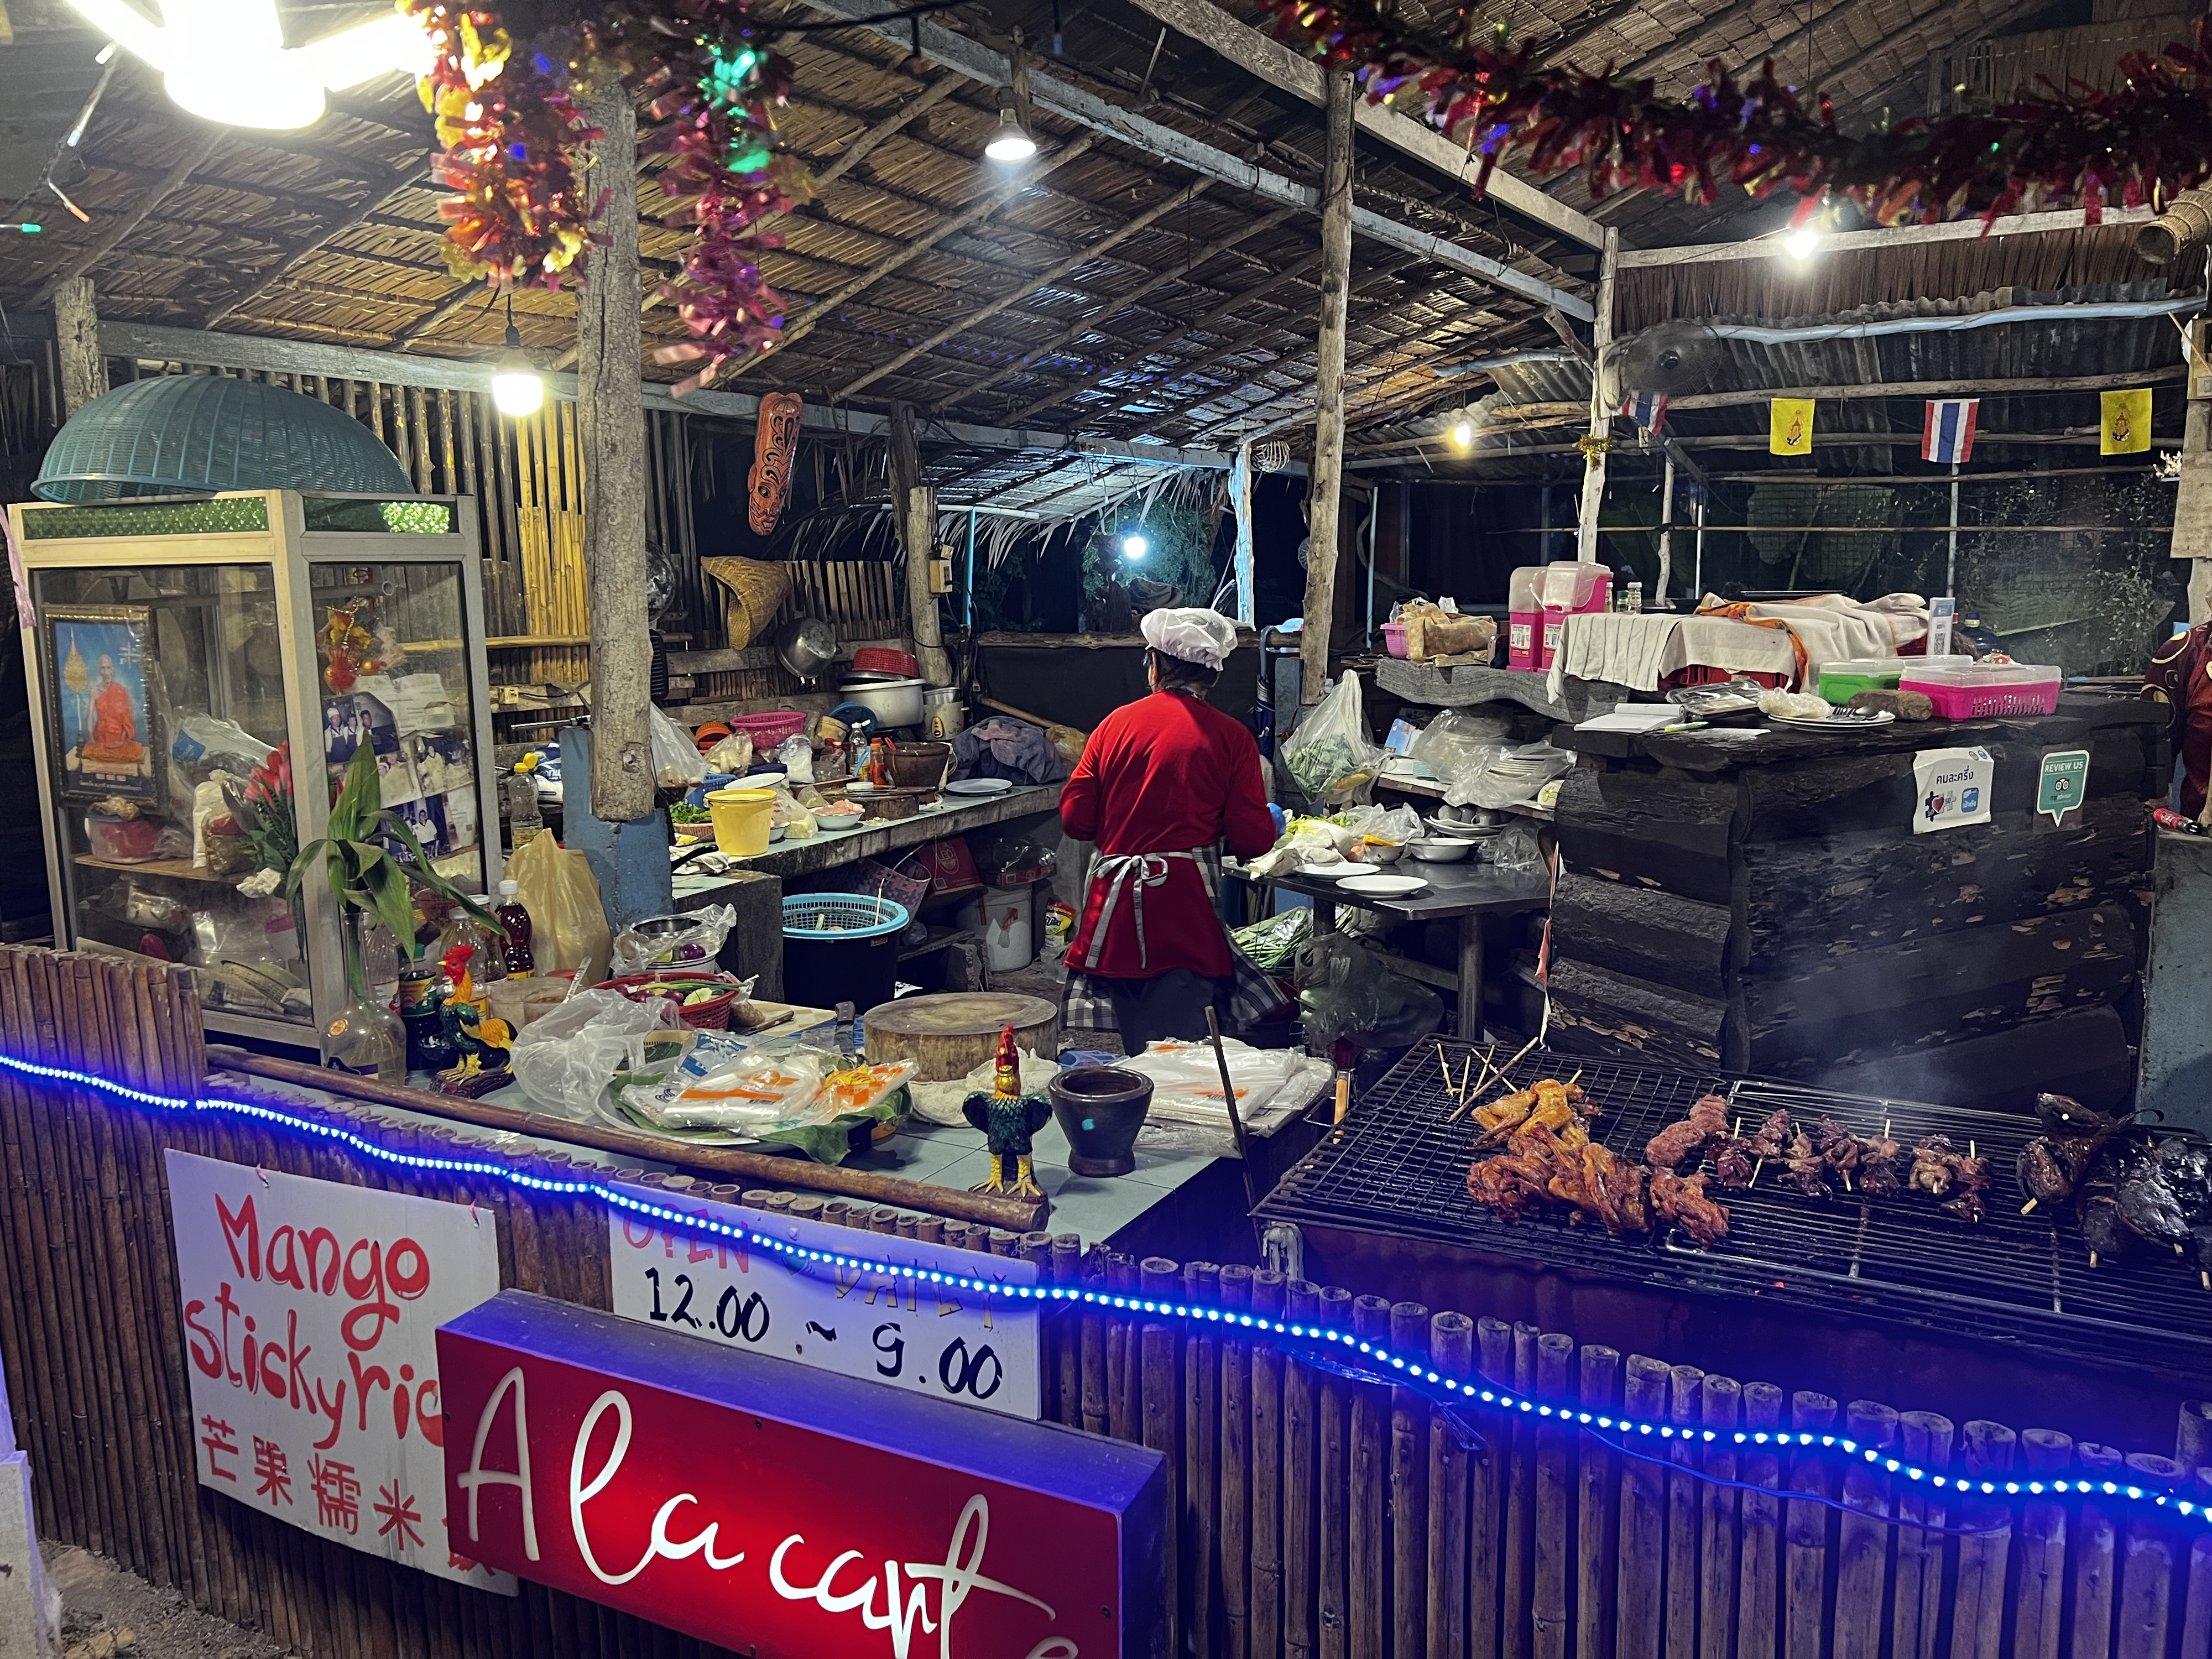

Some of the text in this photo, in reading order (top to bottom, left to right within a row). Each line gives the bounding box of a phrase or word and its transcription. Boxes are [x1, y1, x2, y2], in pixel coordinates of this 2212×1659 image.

[1936, 765, 1974, 784] คนละครึ่ง
[2044, 761, 2084, 773] REVIEW US
[215, 1193, 430, 1352] Mango
[623, 1203, 749, 1274] OPEN
[644, 1267, 770, 1343] 12.00
[831, 1245, 1007, 1329] DAILY
[201, 1414, 496, 1576] 芒果糯米
